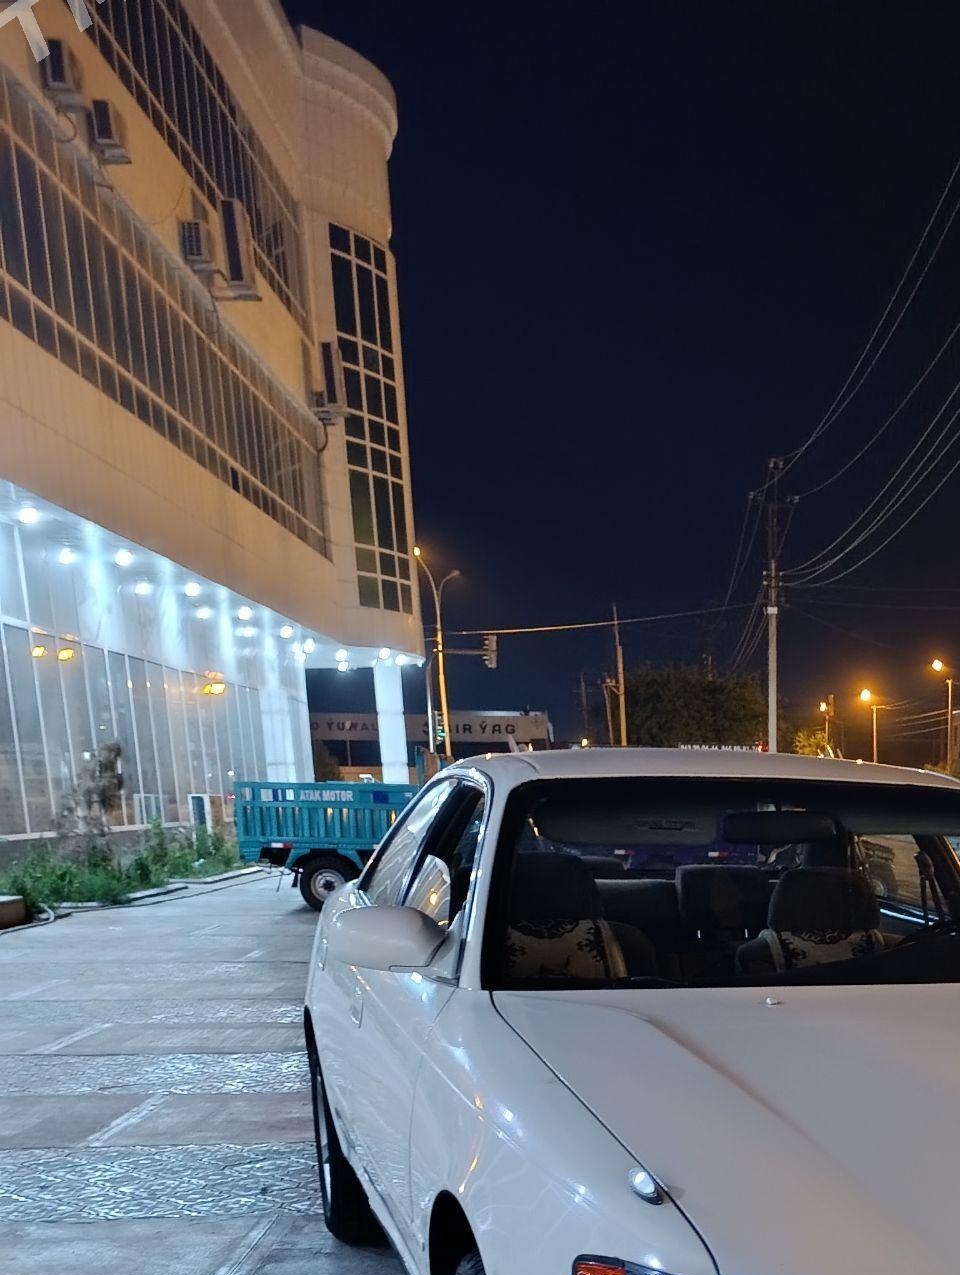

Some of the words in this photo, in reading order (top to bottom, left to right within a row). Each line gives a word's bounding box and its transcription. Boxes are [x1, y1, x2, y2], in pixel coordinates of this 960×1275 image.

[479, 720, 516, 735] ÝAG
[301, 790, 322, 801] ATAK
[323, 790, 354, 802] MOTOR
